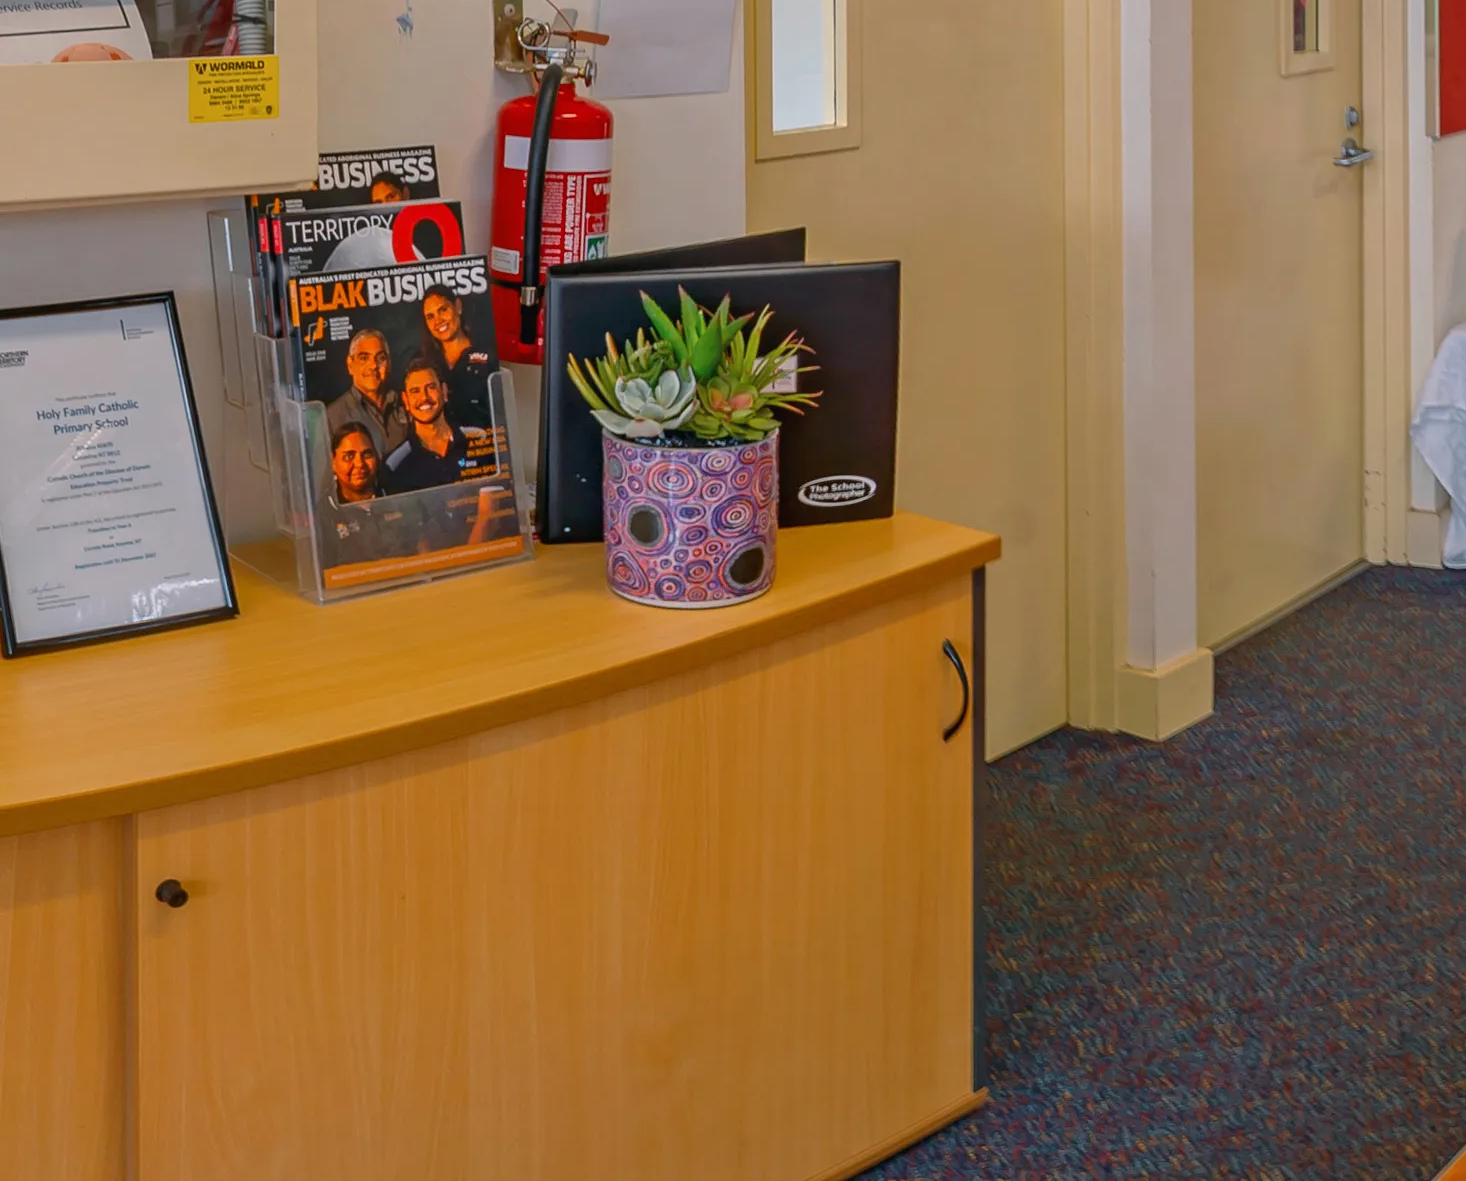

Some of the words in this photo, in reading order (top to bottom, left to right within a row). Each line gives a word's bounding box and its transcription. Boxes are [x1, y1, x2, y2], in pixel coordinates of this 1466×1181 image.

[0, 2, 31, 14] ervice
[34, 0, 83, 11] Records
[210, 60, 265, 72] WORMALD
[213, 85, 233, 93] HOUR
[236, 84, 266, 92] SERVICE
[337, 153, 372, 161] ABORIGINAL
[373, 151, 400, 159] BUSINESS
[401, 148, 432, 157] MAGAZINE
[567, 175, 576, 196] TYPE
[565, 198, 574, 233] POWDER
[285, 214, 393, 243] TERRITORY
[299, 273, 339, 285] AUSTRALIA'S
[339, 271, 355, 281] FIRST
[355, 269, 388, 279] DEDICATED
[389, 265, 424, 276] ABORIGINAL
[426, 262, 453, 271] BUSINESS
[453, 258, 485, 268] MAGAZINE
[300, 280, 366, 314] BLAK
[36, 410, 60, 422] Holy
[63, 404, 97, 418] Family
[98, 400, 139, 413] Catholic
[53, 421, 92, 435] Primary
[95, 417, 129, 430] School
[809, 489, 865, 502] Photographer
[810, 484, 829, 493] The
[832, 482, 865, 492] School
